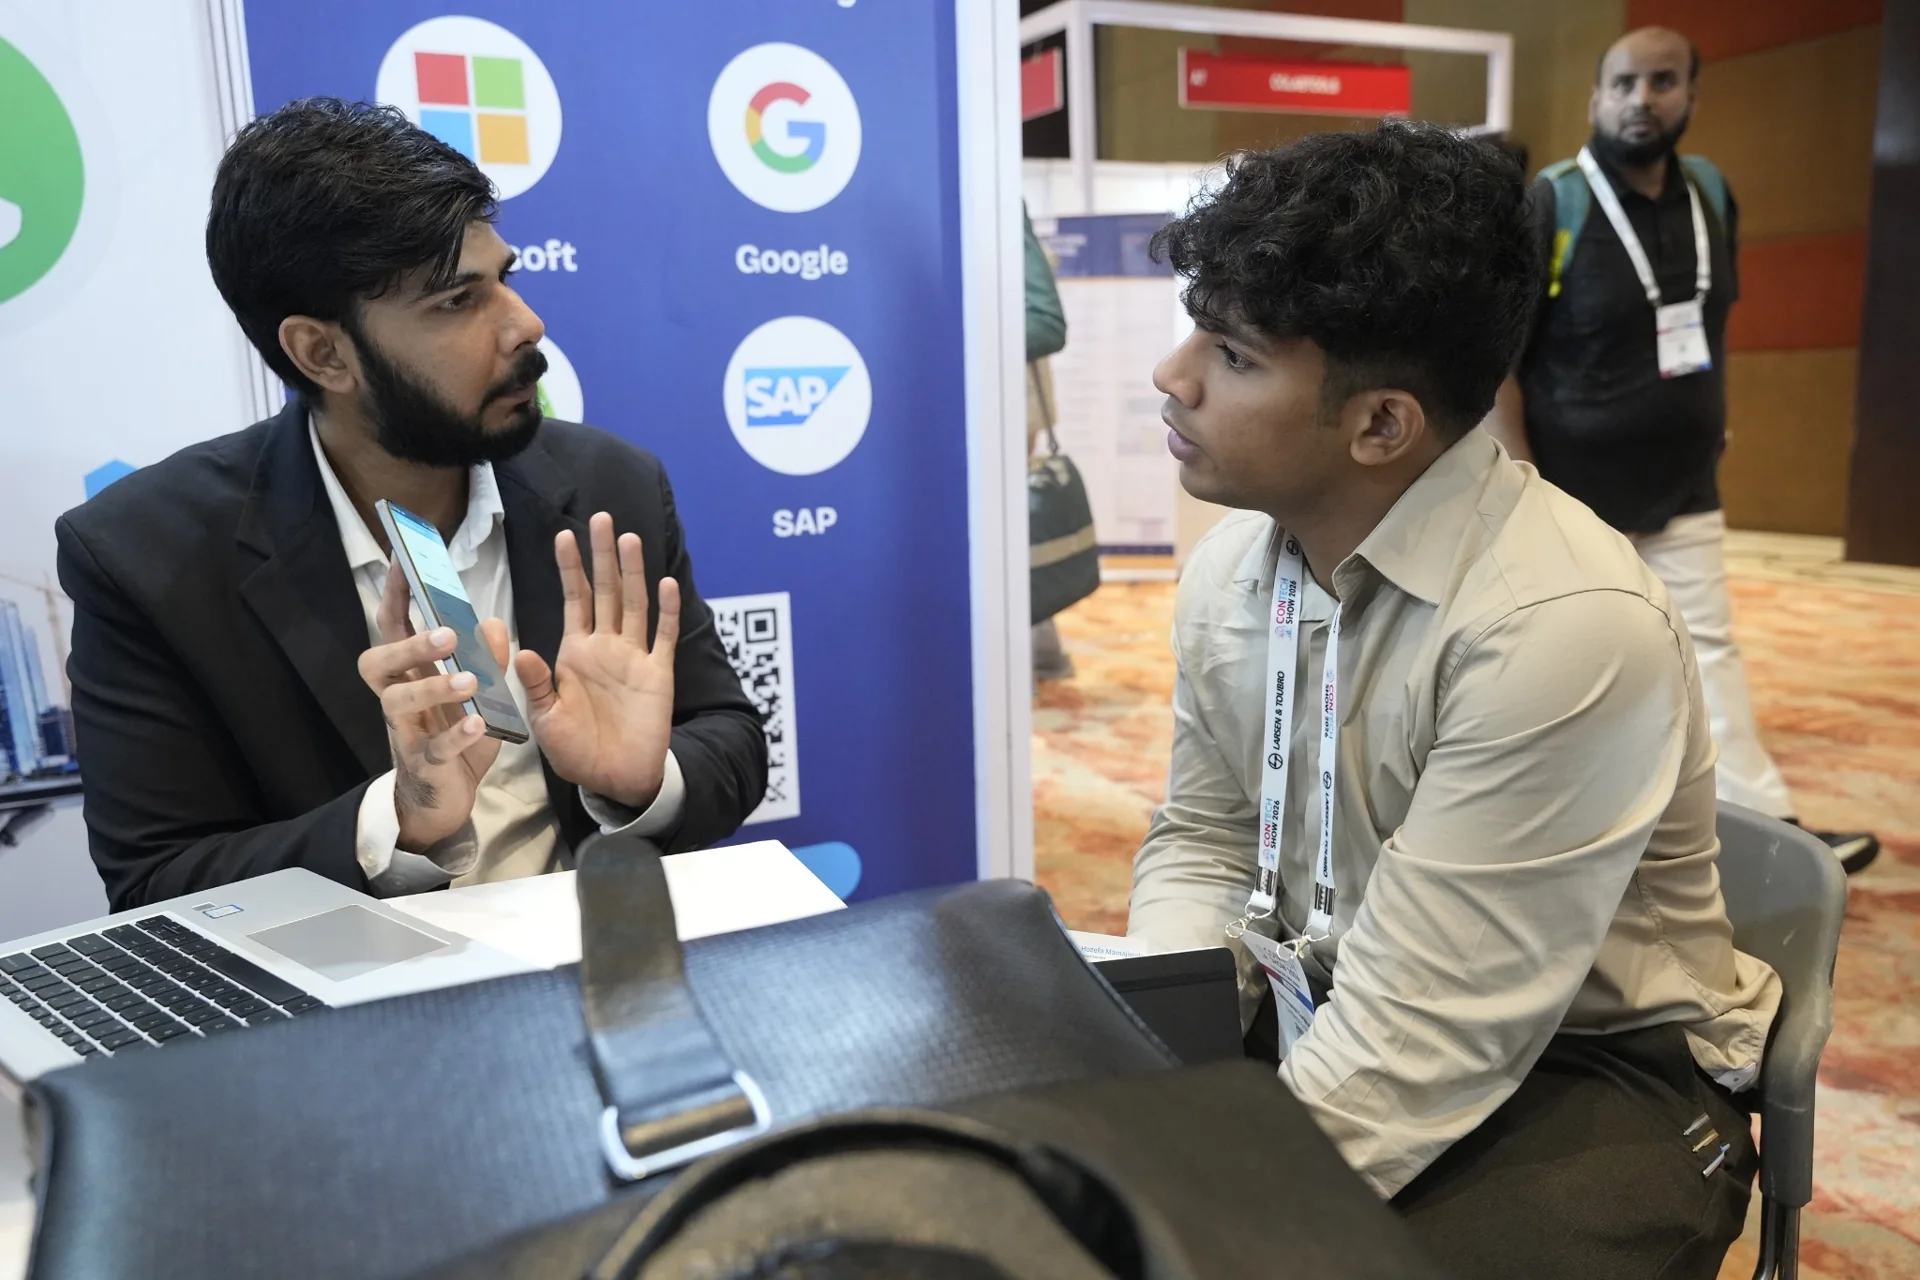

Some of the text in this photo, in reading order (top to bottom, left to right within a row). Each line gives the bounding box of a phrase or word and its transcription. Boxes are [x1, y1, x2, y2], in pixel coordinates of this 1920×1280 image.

[744, 82, 826, 174] G
[736, 243, 849, 281] Google
[746, 376, 828, 418] SAP
[772, 506, 838, 538] SAP
[1276, 577, 1289, 624] CONTECH
[1285, 580, 1297, 624] SHOW 2026
[1273, 671, 1285, 750] LARSEN & TOUBRO
[1263, 798, 1273, 847] CONTECH
[1270, 800, 1281, 849] SHOW 2026
